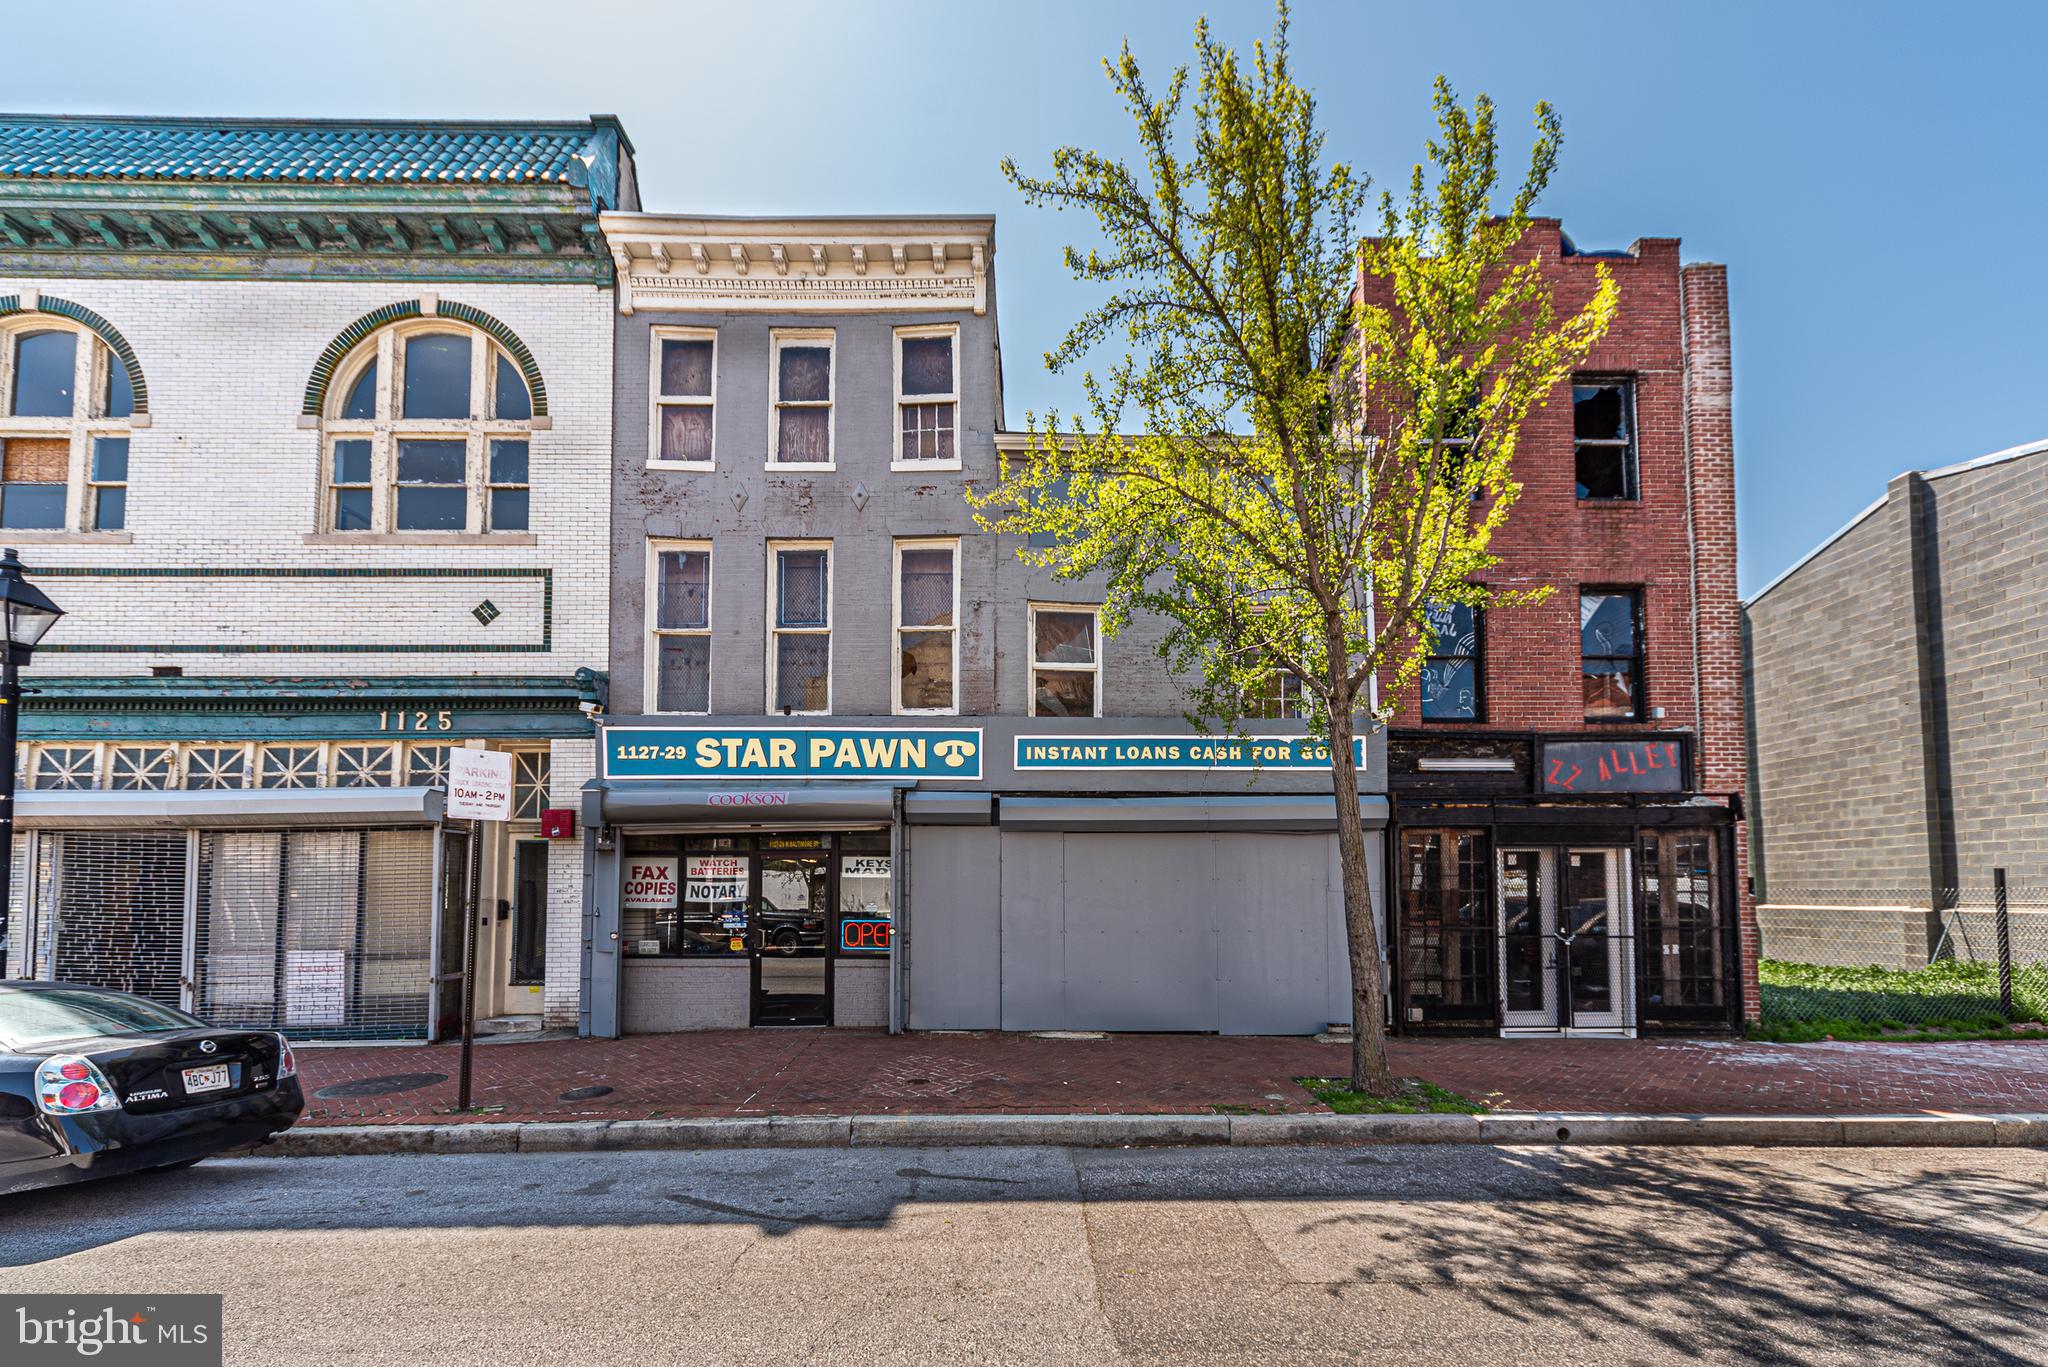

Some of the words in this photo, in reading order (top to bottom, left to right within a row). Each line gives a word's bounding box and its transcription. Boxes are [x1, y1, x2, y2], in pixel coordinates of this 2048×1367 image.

[380, 711, 452, 730] 1125
[617, 745, 687, 760] 1127-29
[695, 737, 797, 768] STAR
[810, 738, 926, 768] PAWN
[1026, 746, 1108, 760] INSTANT
[1115, 746, 1180, 760] LOANS
[1189, 746, 1241, 760] CASH
[1252, 746, 1291, 760] FOR
[1300, 746, 1330, 760] GO
[1598, 742, 1678, 782] ALLEY
[455, 766, 508, 780] PARKING
[709, 791, 786, 806] COOKSON
[699, 859, 738, 867] WATCH
[855, 859, 891, 868] KEYS
[632, 865, 669, 880] FAX
[690, 867, 745, 876] BATTERIES
[845, 867, 891, 875] MAD
[624, 881, 676, 896] COPIES
[690, 884, 745, 899] NOTARY
[187, 1074, 204, 1087] 4BC
[211, 1071, 227, 1084] J77
[124, 1091, 169, 1104] ALTIMA
